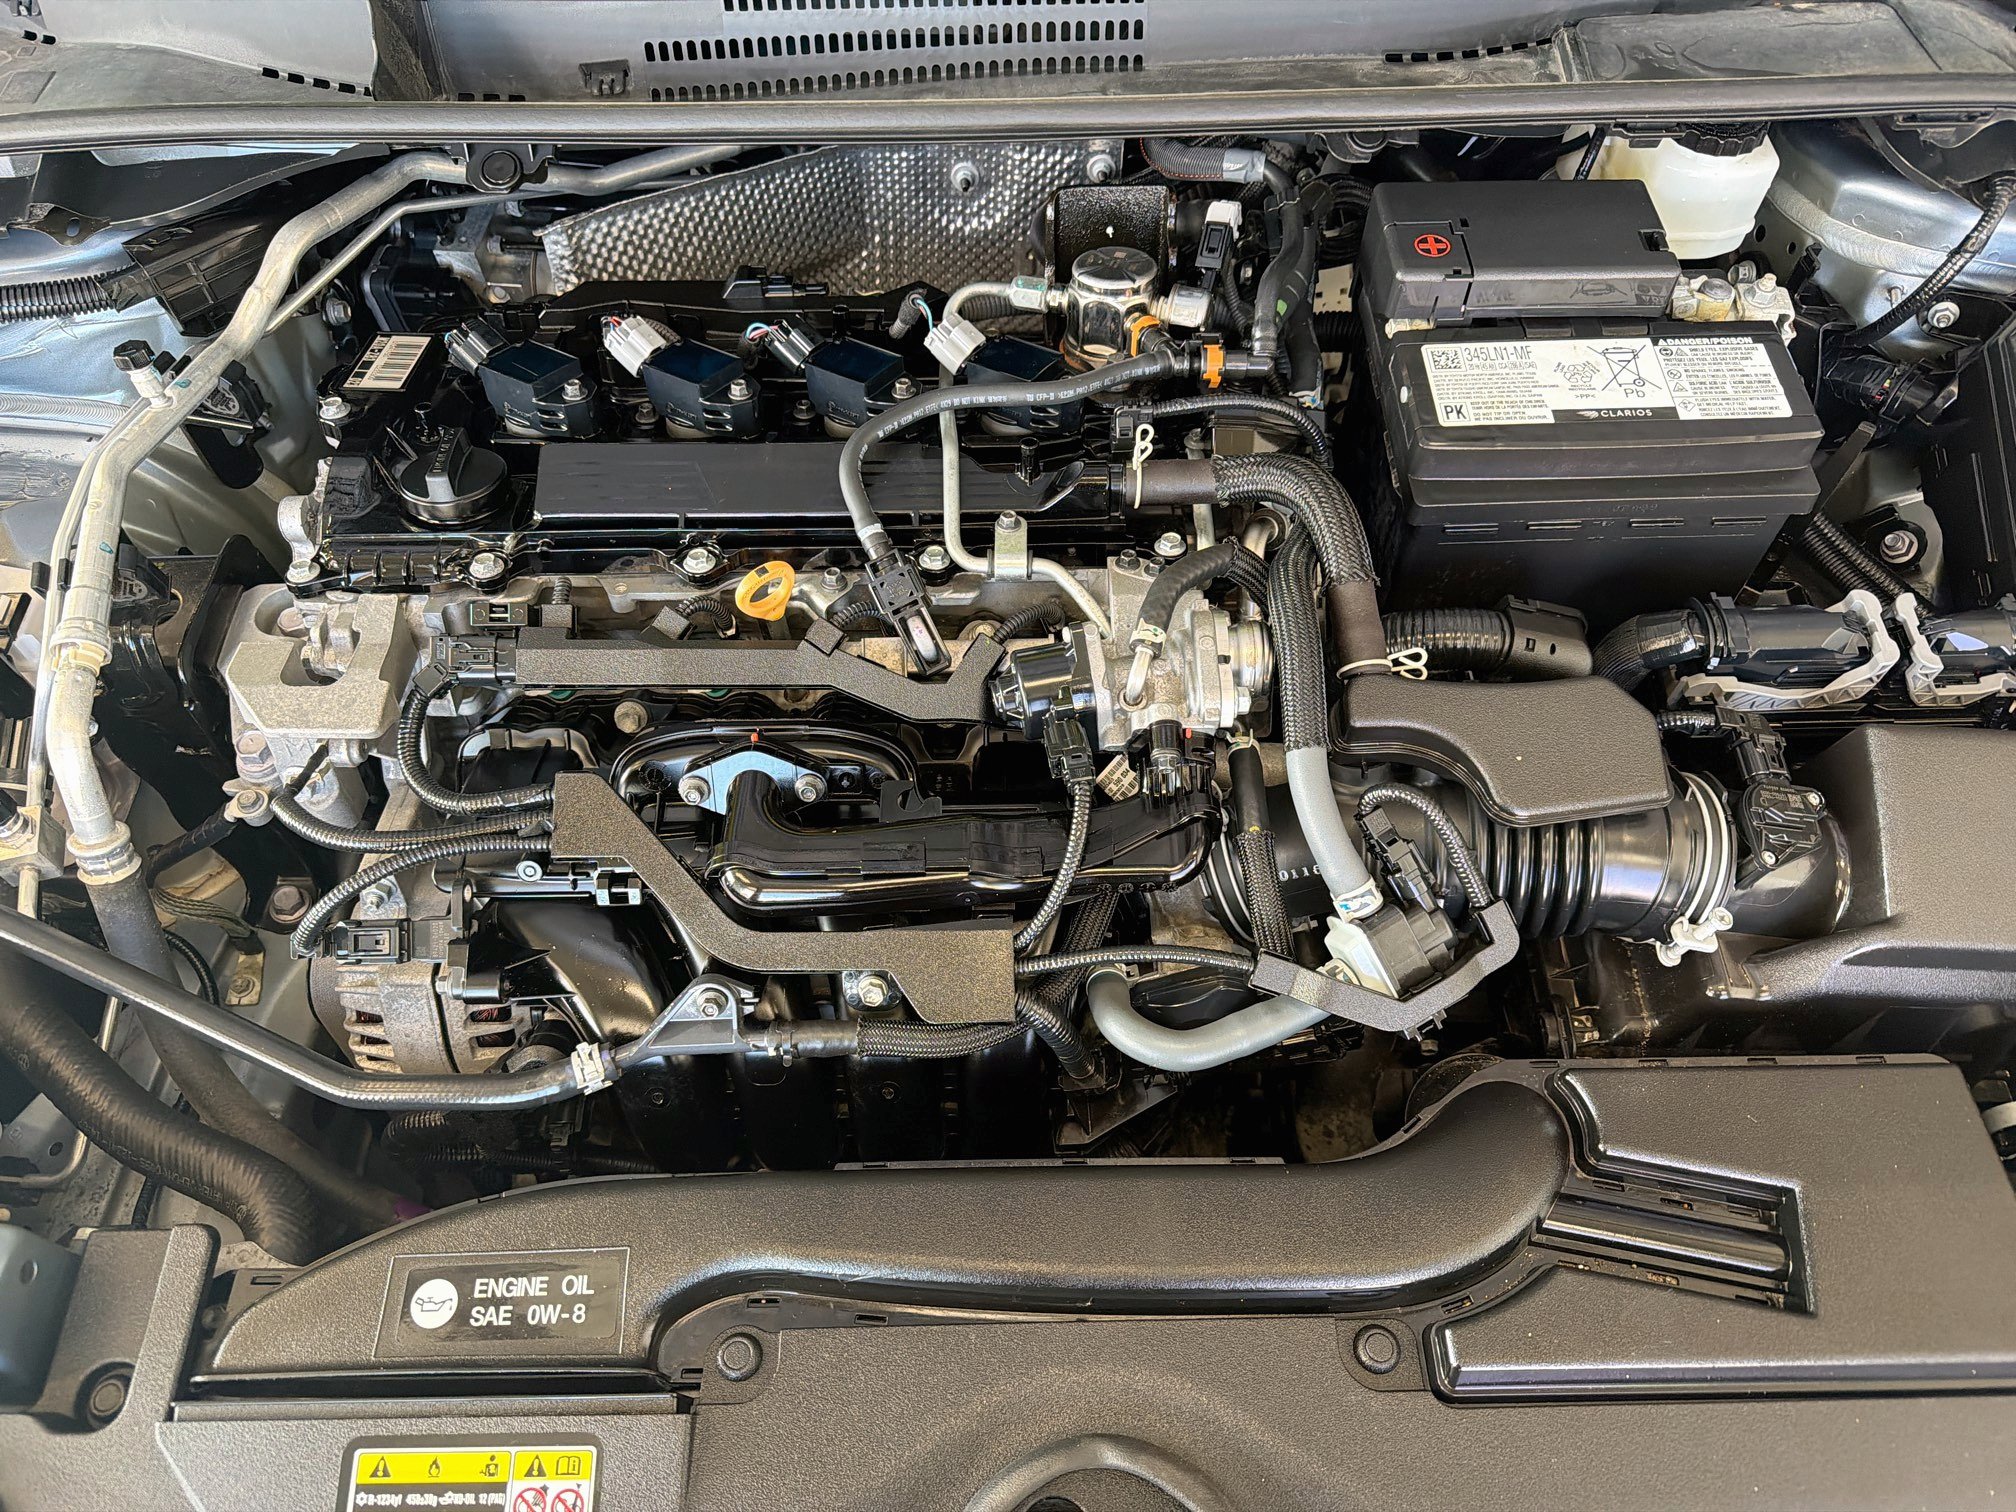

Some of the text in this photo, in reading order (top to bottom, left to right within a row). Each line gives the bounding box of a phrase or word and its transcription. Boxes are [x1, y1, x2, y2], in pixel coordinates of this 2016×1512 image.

[1666, 336, 1754, 345] DANGER/POISON
[1464, 346, 1532, 361] 345LN1-MF
[1624, 388, 1646, 398] Pb
[1444, 404, 1467, 420] PK
[1600, 409, 1653, 418] CLARIOS
[473, 1275, 595, 1298] ENGINE OIL
[469, 1303, 587, 1327] SAE 0W-8
